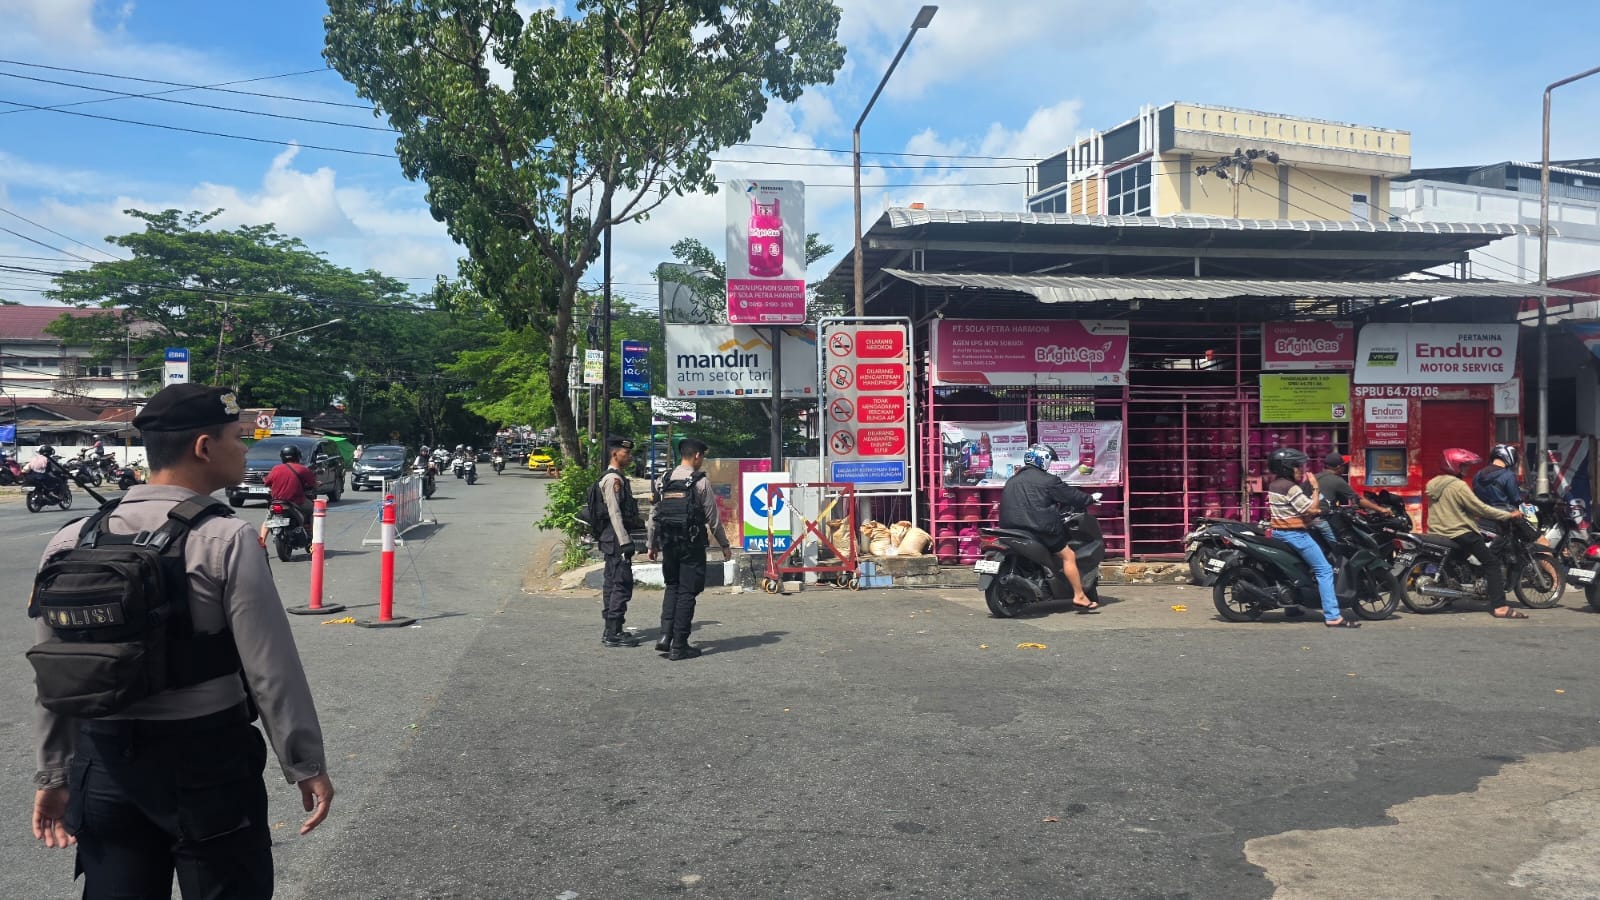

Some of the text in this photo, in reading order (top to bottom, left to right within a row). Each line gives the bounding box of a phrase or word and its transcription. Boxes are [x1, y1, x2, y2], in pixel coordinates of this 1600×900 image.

[965, 325, 985, 333] SOLA
[986, 325, 1010, 333] PETRA
[1012, 325, 1050, 333] HARMONI
[1458, 334, 1502, 342] PERTAMINA
[1275, 337, 1339, 356] Bright Gas
[1415, 342, 1503, 358] Enduro
[677, 349, 759, 369] mandiri
[1035, 345, 1104, 365] Bright Gas
[1420, 362, 1504, 373] MOTOR SERVICE
[677, 370, 705, 382] atm
[709, 370, 744, 381] setor
[1355, 386, 1439, 397] SPBU 64.781.06
[1371, 406, 1404, 416] Enduro
[749, 537, 786, 548] MASUK
[47, 606, 115, 625] POLISI
